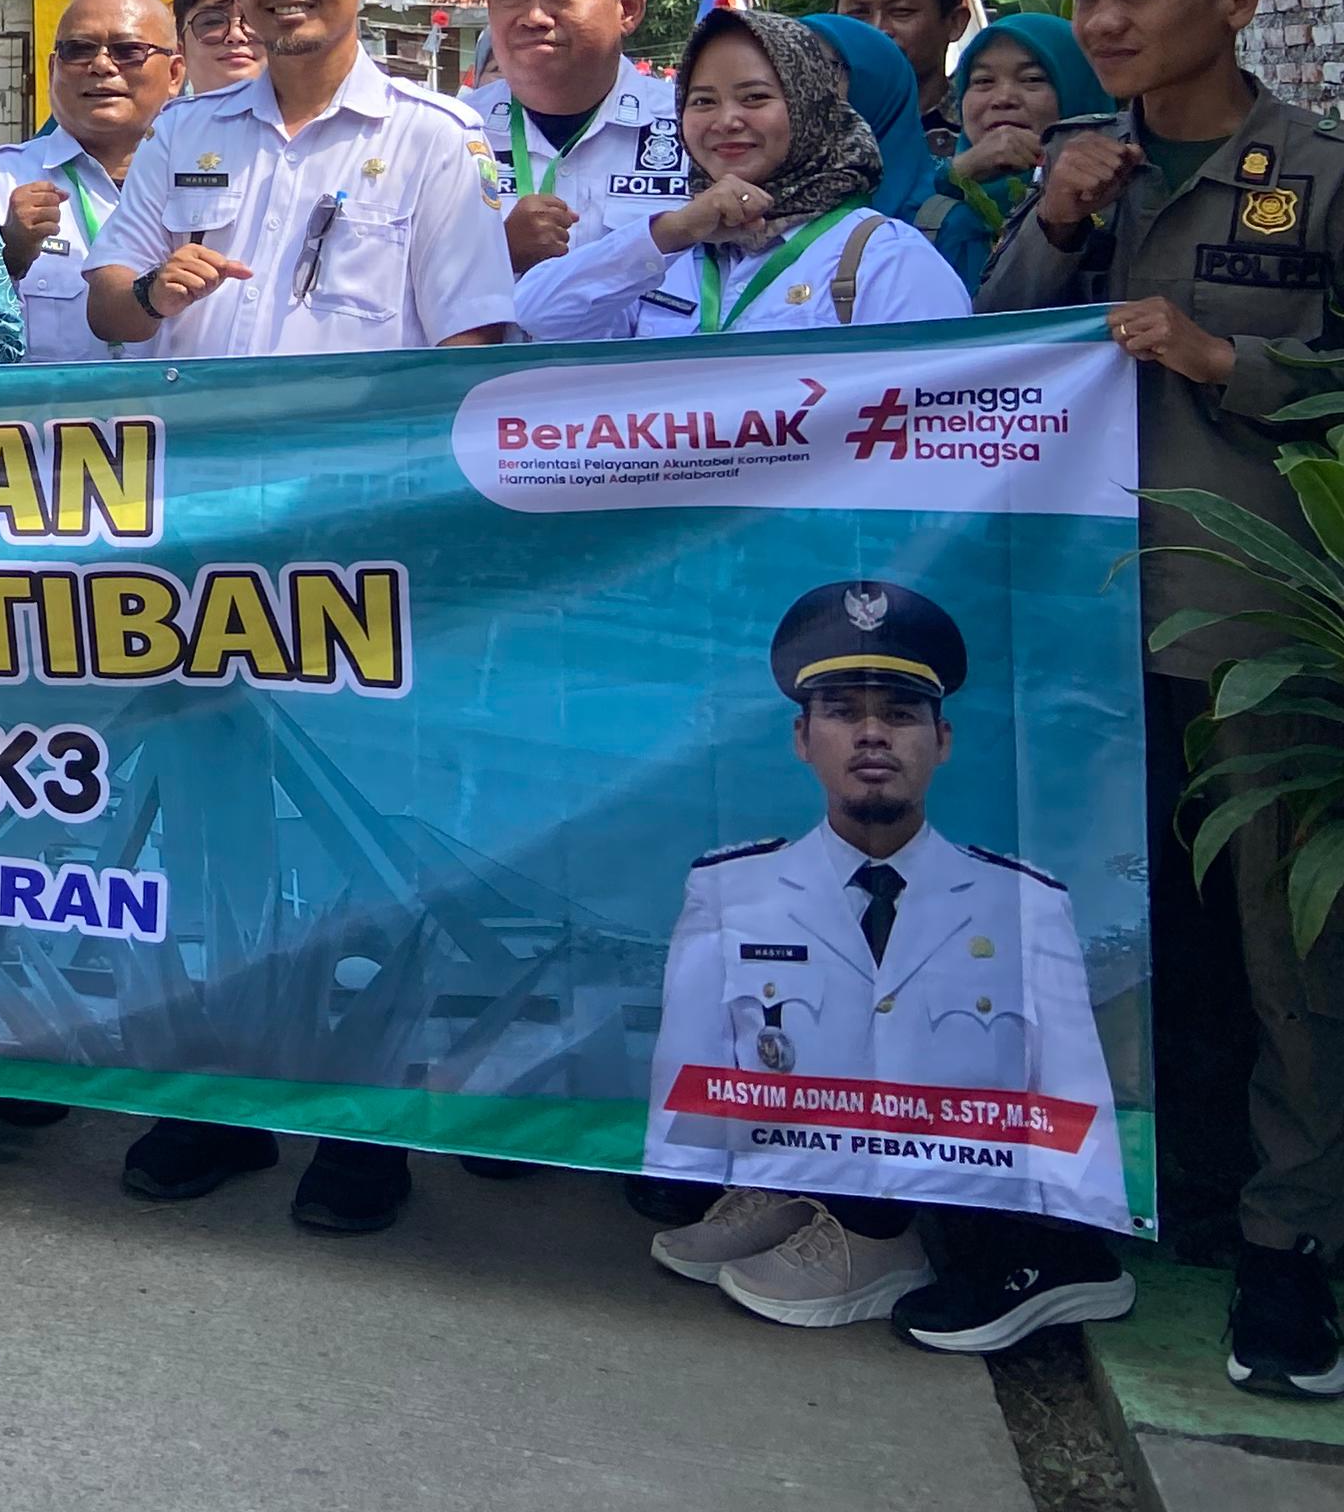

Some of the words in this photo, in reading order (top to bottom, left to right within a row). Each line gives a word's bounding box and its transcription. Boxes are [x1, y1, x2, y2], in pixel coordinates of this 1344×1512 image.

[613, 177, 661, 193] POL
[669, 177, 688, 194] P
[1207, 253, 1269, 279] POL
[915, 387, 1042, 412] bangga
[497, 409, 810, 451] BerAKHLAK
[914, 409, 1068, 439] melayani
[498, 458, 581, 471] Berorientasi
[584, 458, 659, 473] Pelayanan
[663, 456, 734, 470] Akuntabel
[737, 452, 810, 466] Kompeten
[915, 438, 1041, 468] bangsa
[499, 473, 566, 485] Harmonis
[569, 473, 605, 486] Loyal
[609, 471, 660, 486] Adaptif
[706, 1077, 787, 1109] HASYIM
[792, 1086, 864, 1114] ADNAN
[869, 1091, 935, 1126] ADHA,
[751, 1126, 843, 1152] CAMAT
[850, 1134, 1014, 1169] PEBAYURAN
